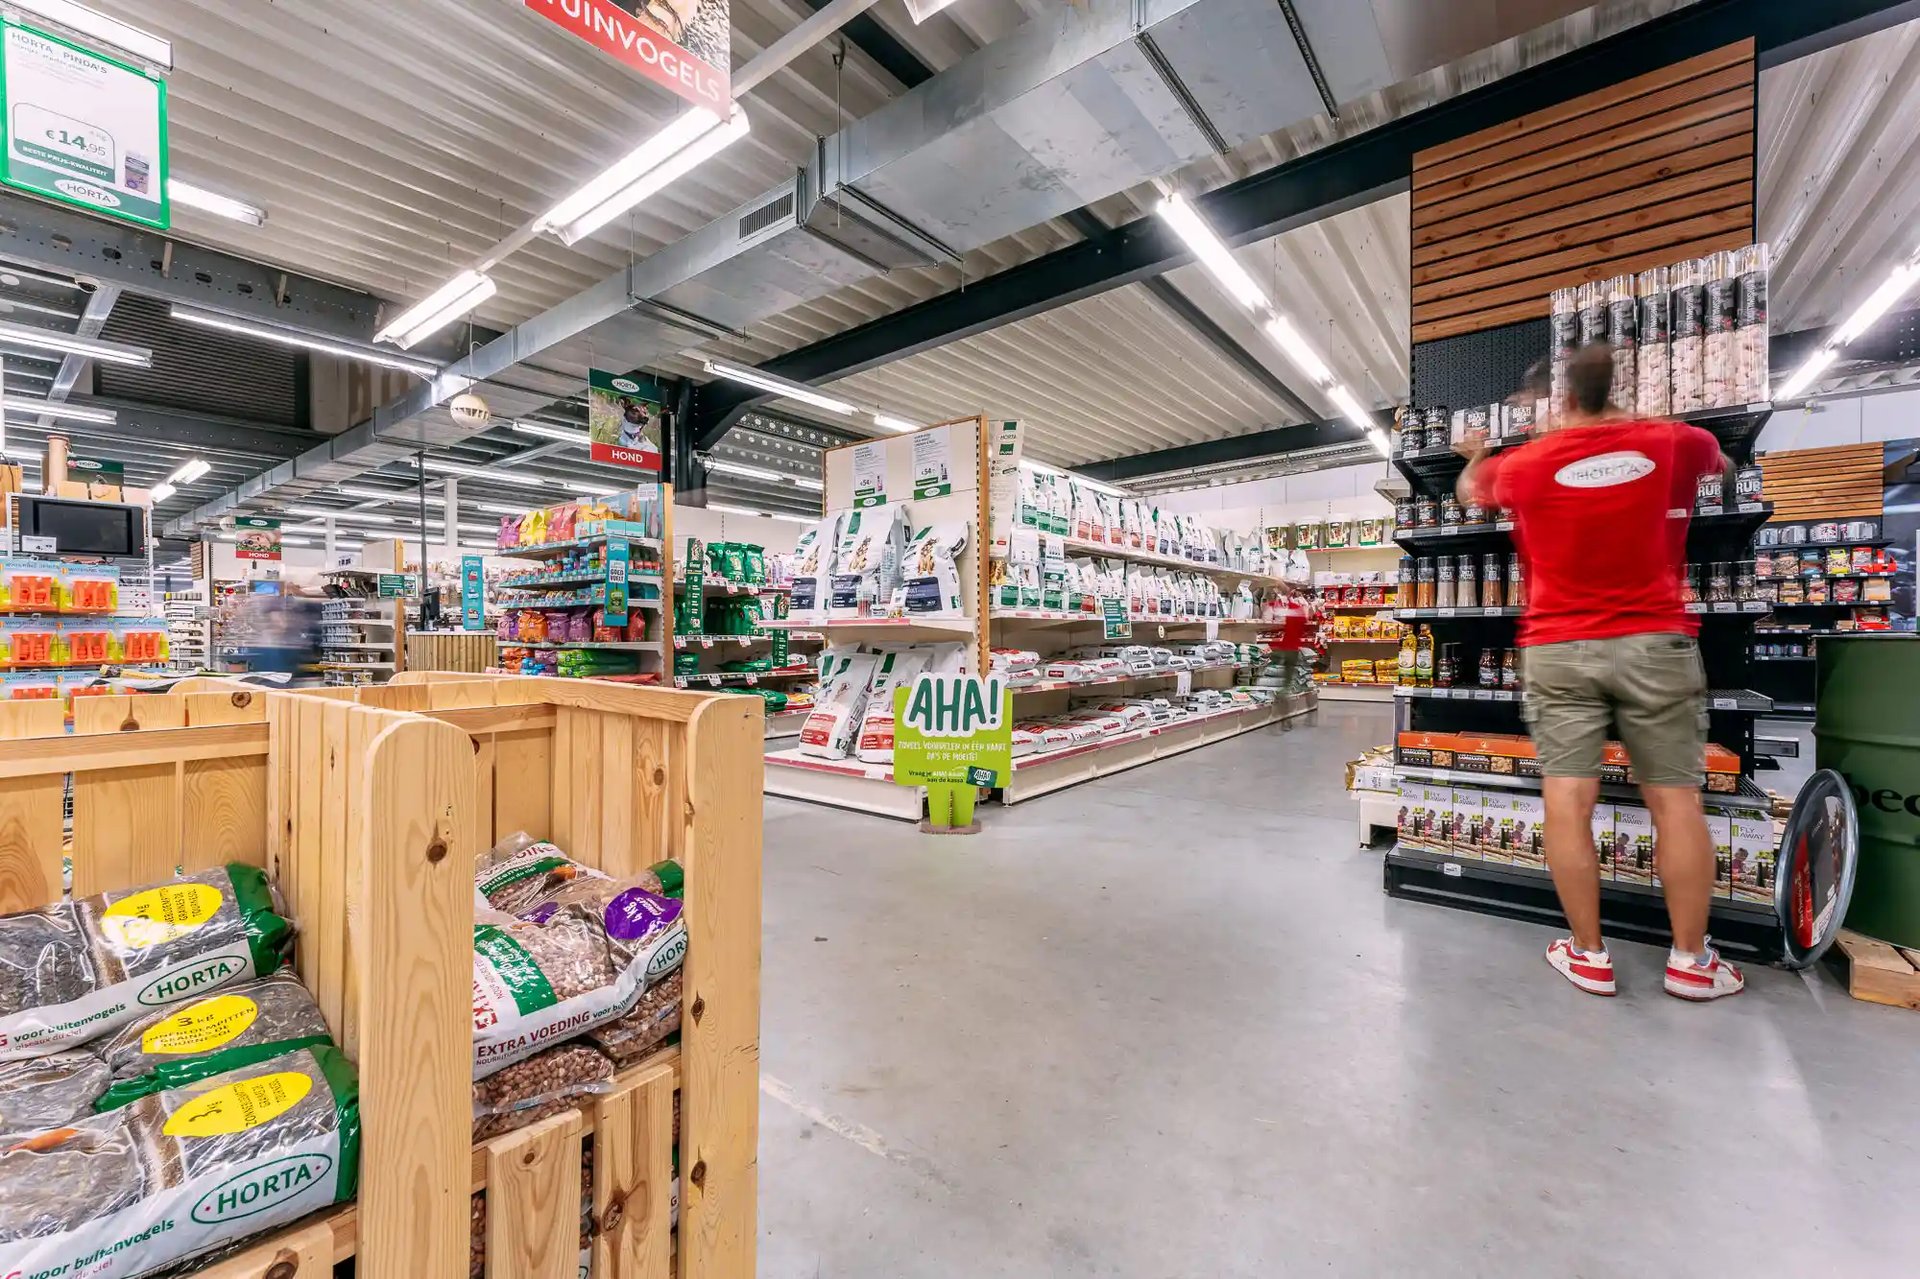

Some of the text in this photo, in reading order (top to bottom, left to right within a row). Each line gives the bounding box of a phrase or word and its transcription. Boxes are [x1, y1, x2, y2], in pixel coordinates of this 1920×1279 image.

[11, 31, 54, 54] HORTA
[63, 51, 108, 74] PINDA'S
[546, 0, 721, 102] UINVOGELS
[22, 145, 47, 158] BESTE
[66, 183, 112, 203] HORTA
[616, 381, 636, 390] HORTA
[611, 450, 643, 463] HOND
[1571, 463, 1641, 482] HORTA
[1698, 484, 1721, 497] RUB
[1735, 480, 1760, 494] RUB
[908, 677, 998, 731] AHA!
[1739, 832, 1765, 840] AWAY
[1740, 826, 1755, 834] FLY
[623, 901, 643, 923] 4 kg
[656, 938, 688, 970] HOR
[157, 962, 232, 999] HORTA
[14, 1028, 45, 1043] voor
[52, 1033, 63, 1041] du
[477, 1035, 526, 1058] EXTRA
[530, 1010, 590, 1042] VOEDING
[592, 1006, 611, 1019] voor
[217, 1162, 312, 1215] HORTA
[29, 1261, 70, 1279] voor
[74, 1219, 175, 1270] buitenvogels
